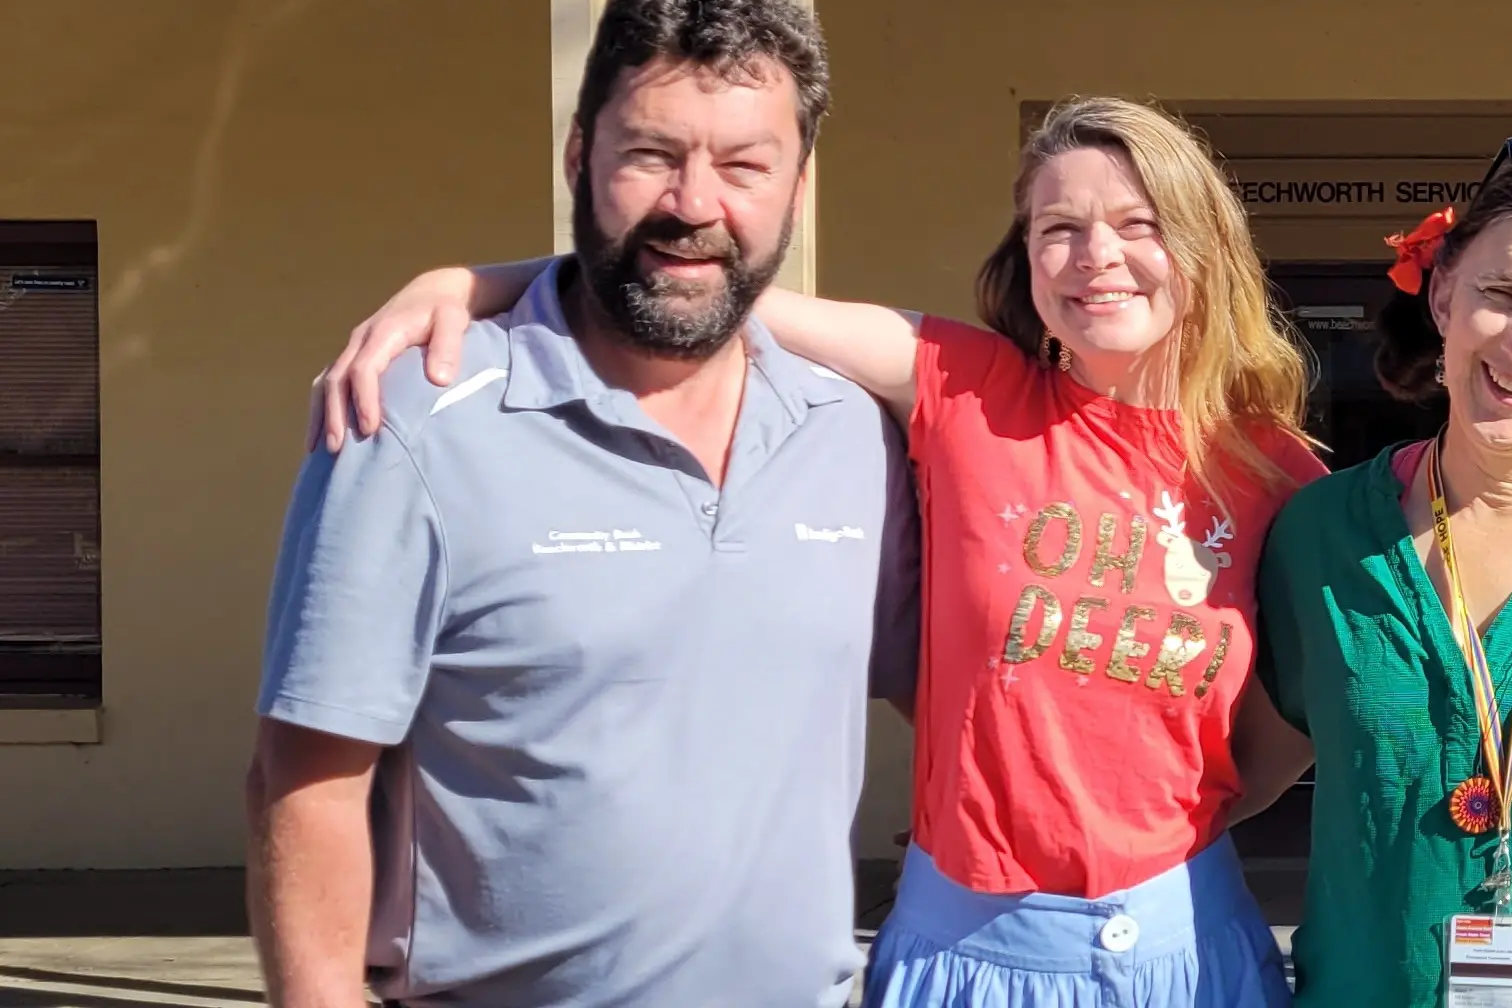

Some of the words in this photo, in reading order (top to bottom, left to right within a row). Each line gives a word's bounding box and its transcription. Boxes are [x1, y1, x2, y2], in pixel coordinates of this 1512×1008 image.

[1023, 500, 1149, 594] OH
[1434, 507, 1448, 543] HOPE
[1003, 583, 1234, 699] DEER!
